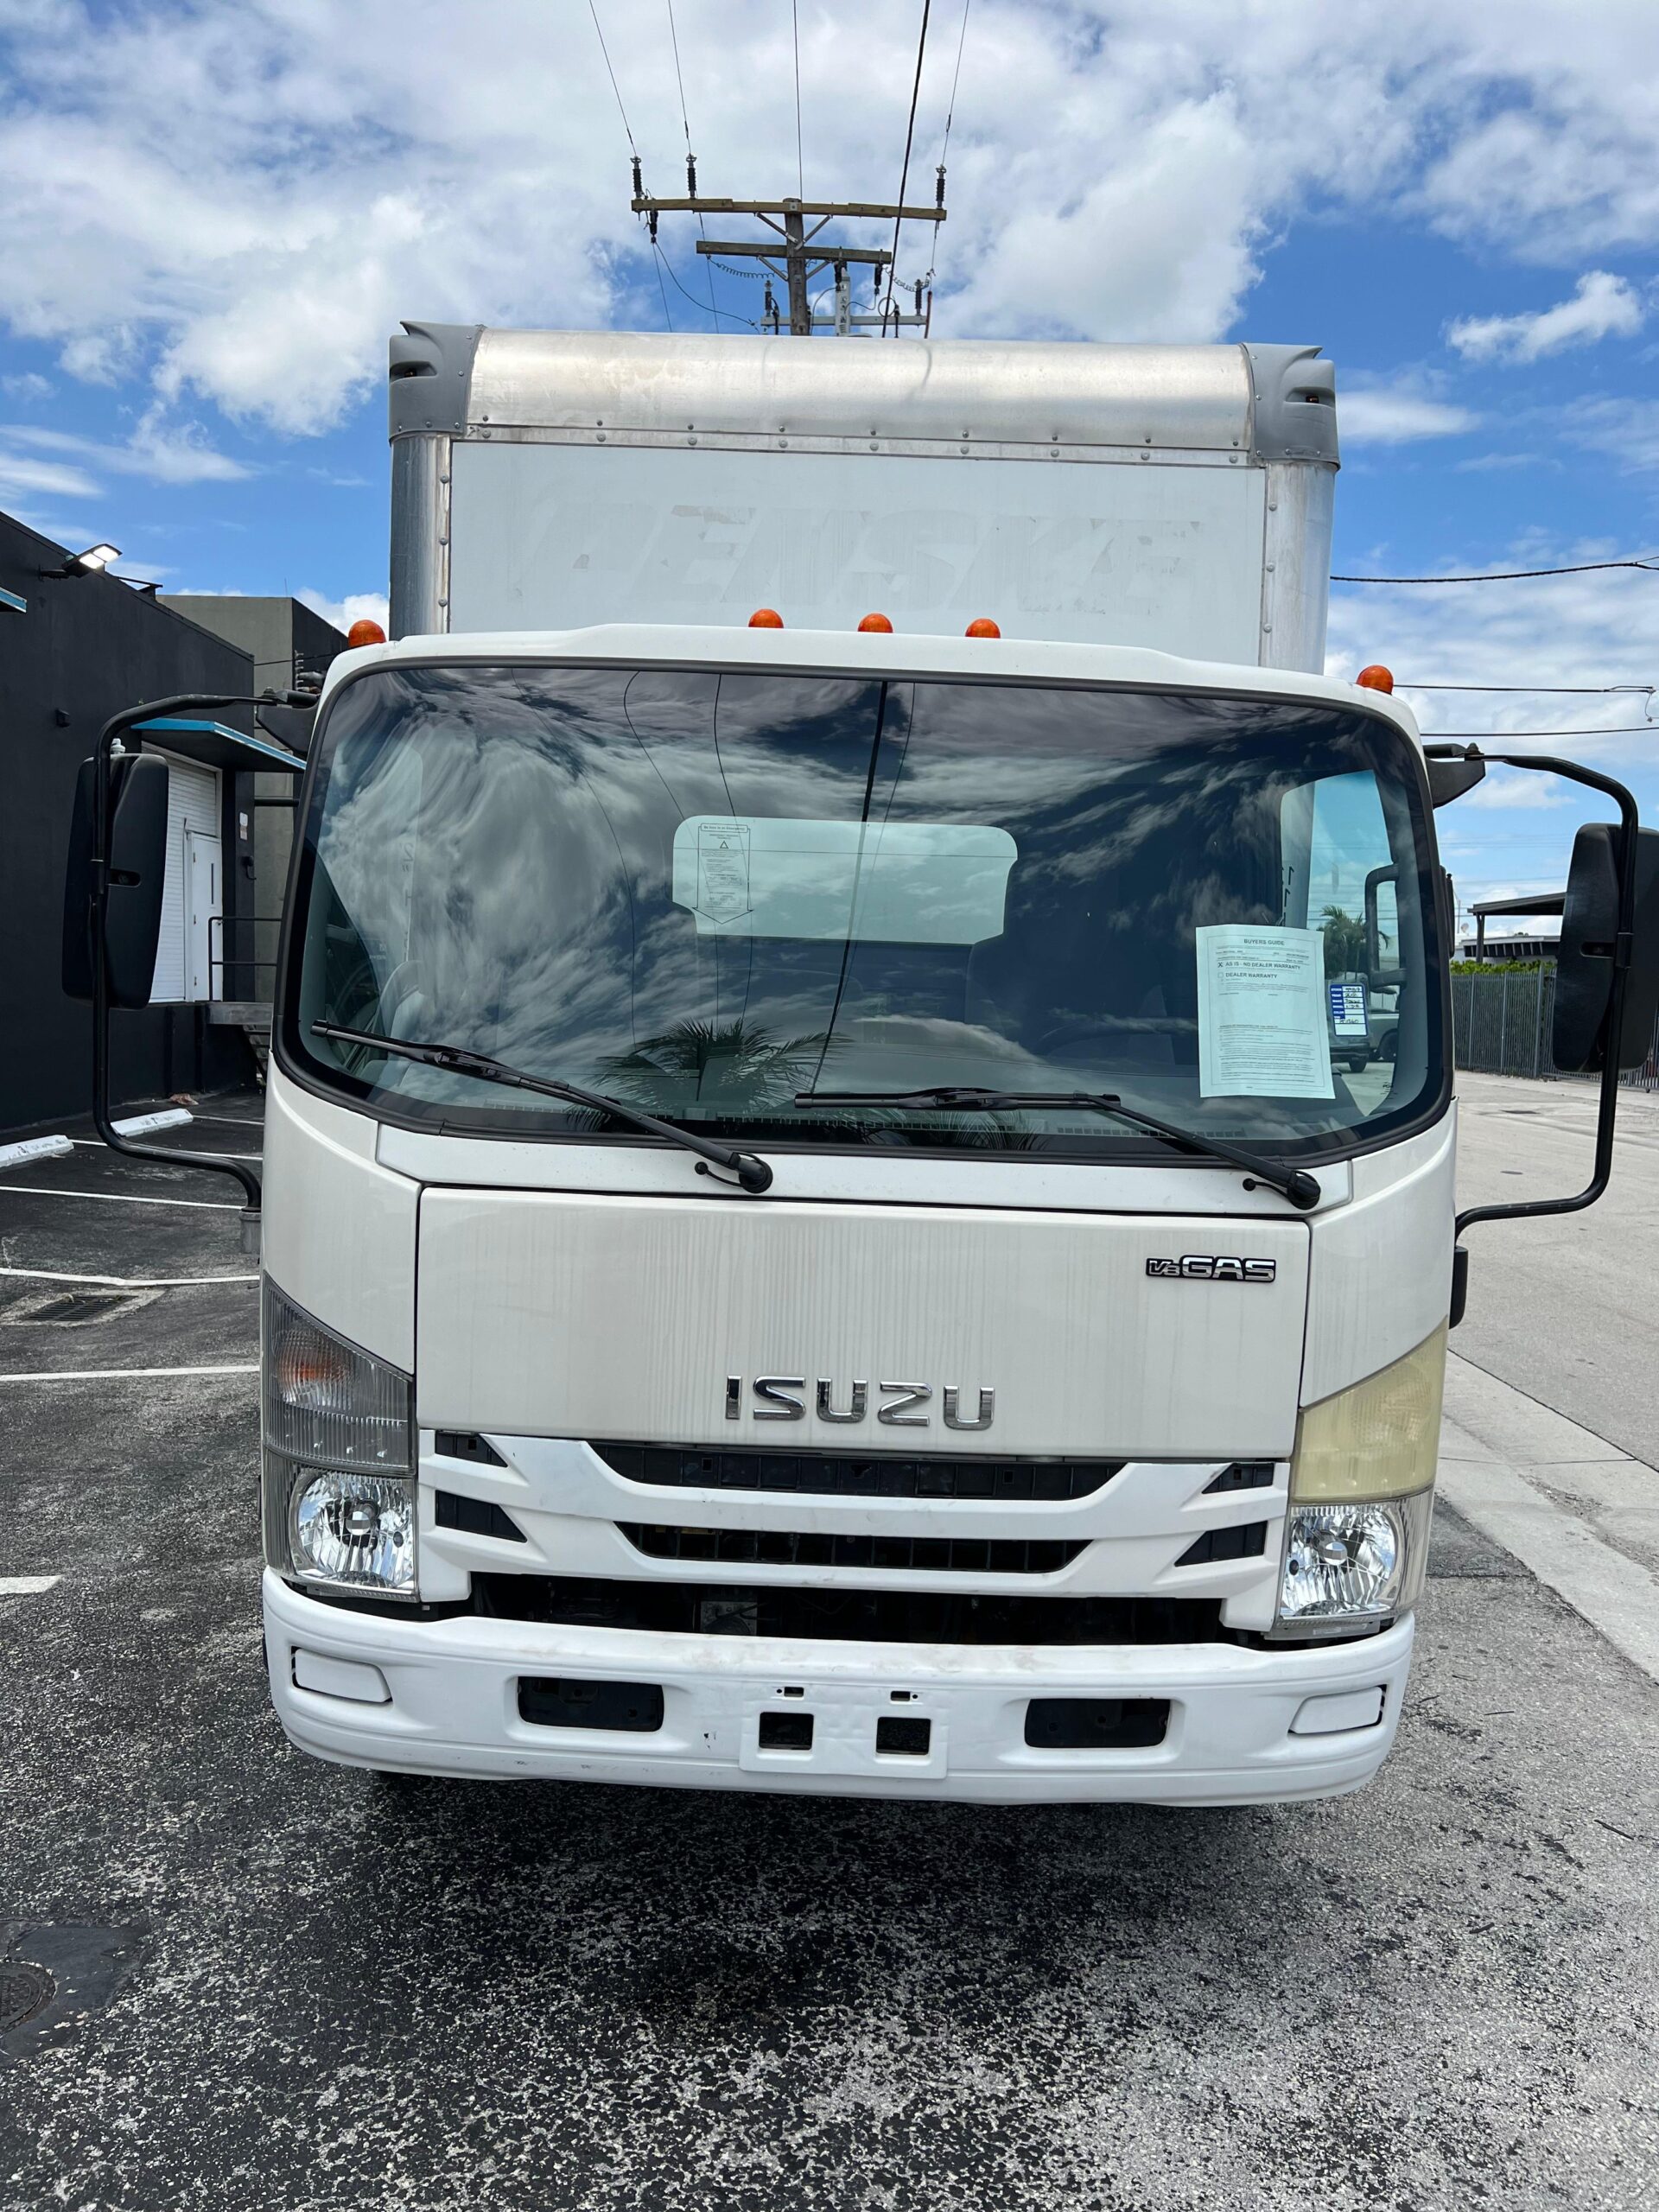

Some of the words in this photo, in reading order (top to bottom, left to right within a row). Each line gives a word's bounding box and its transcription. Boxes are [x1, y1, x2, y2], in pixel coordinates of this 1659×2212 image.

[1149, 1260, 1180, 1276] V8
[1182, 1256, 1275, 1282] GAS
[725, 1375, 995, 1431] ISUZU
